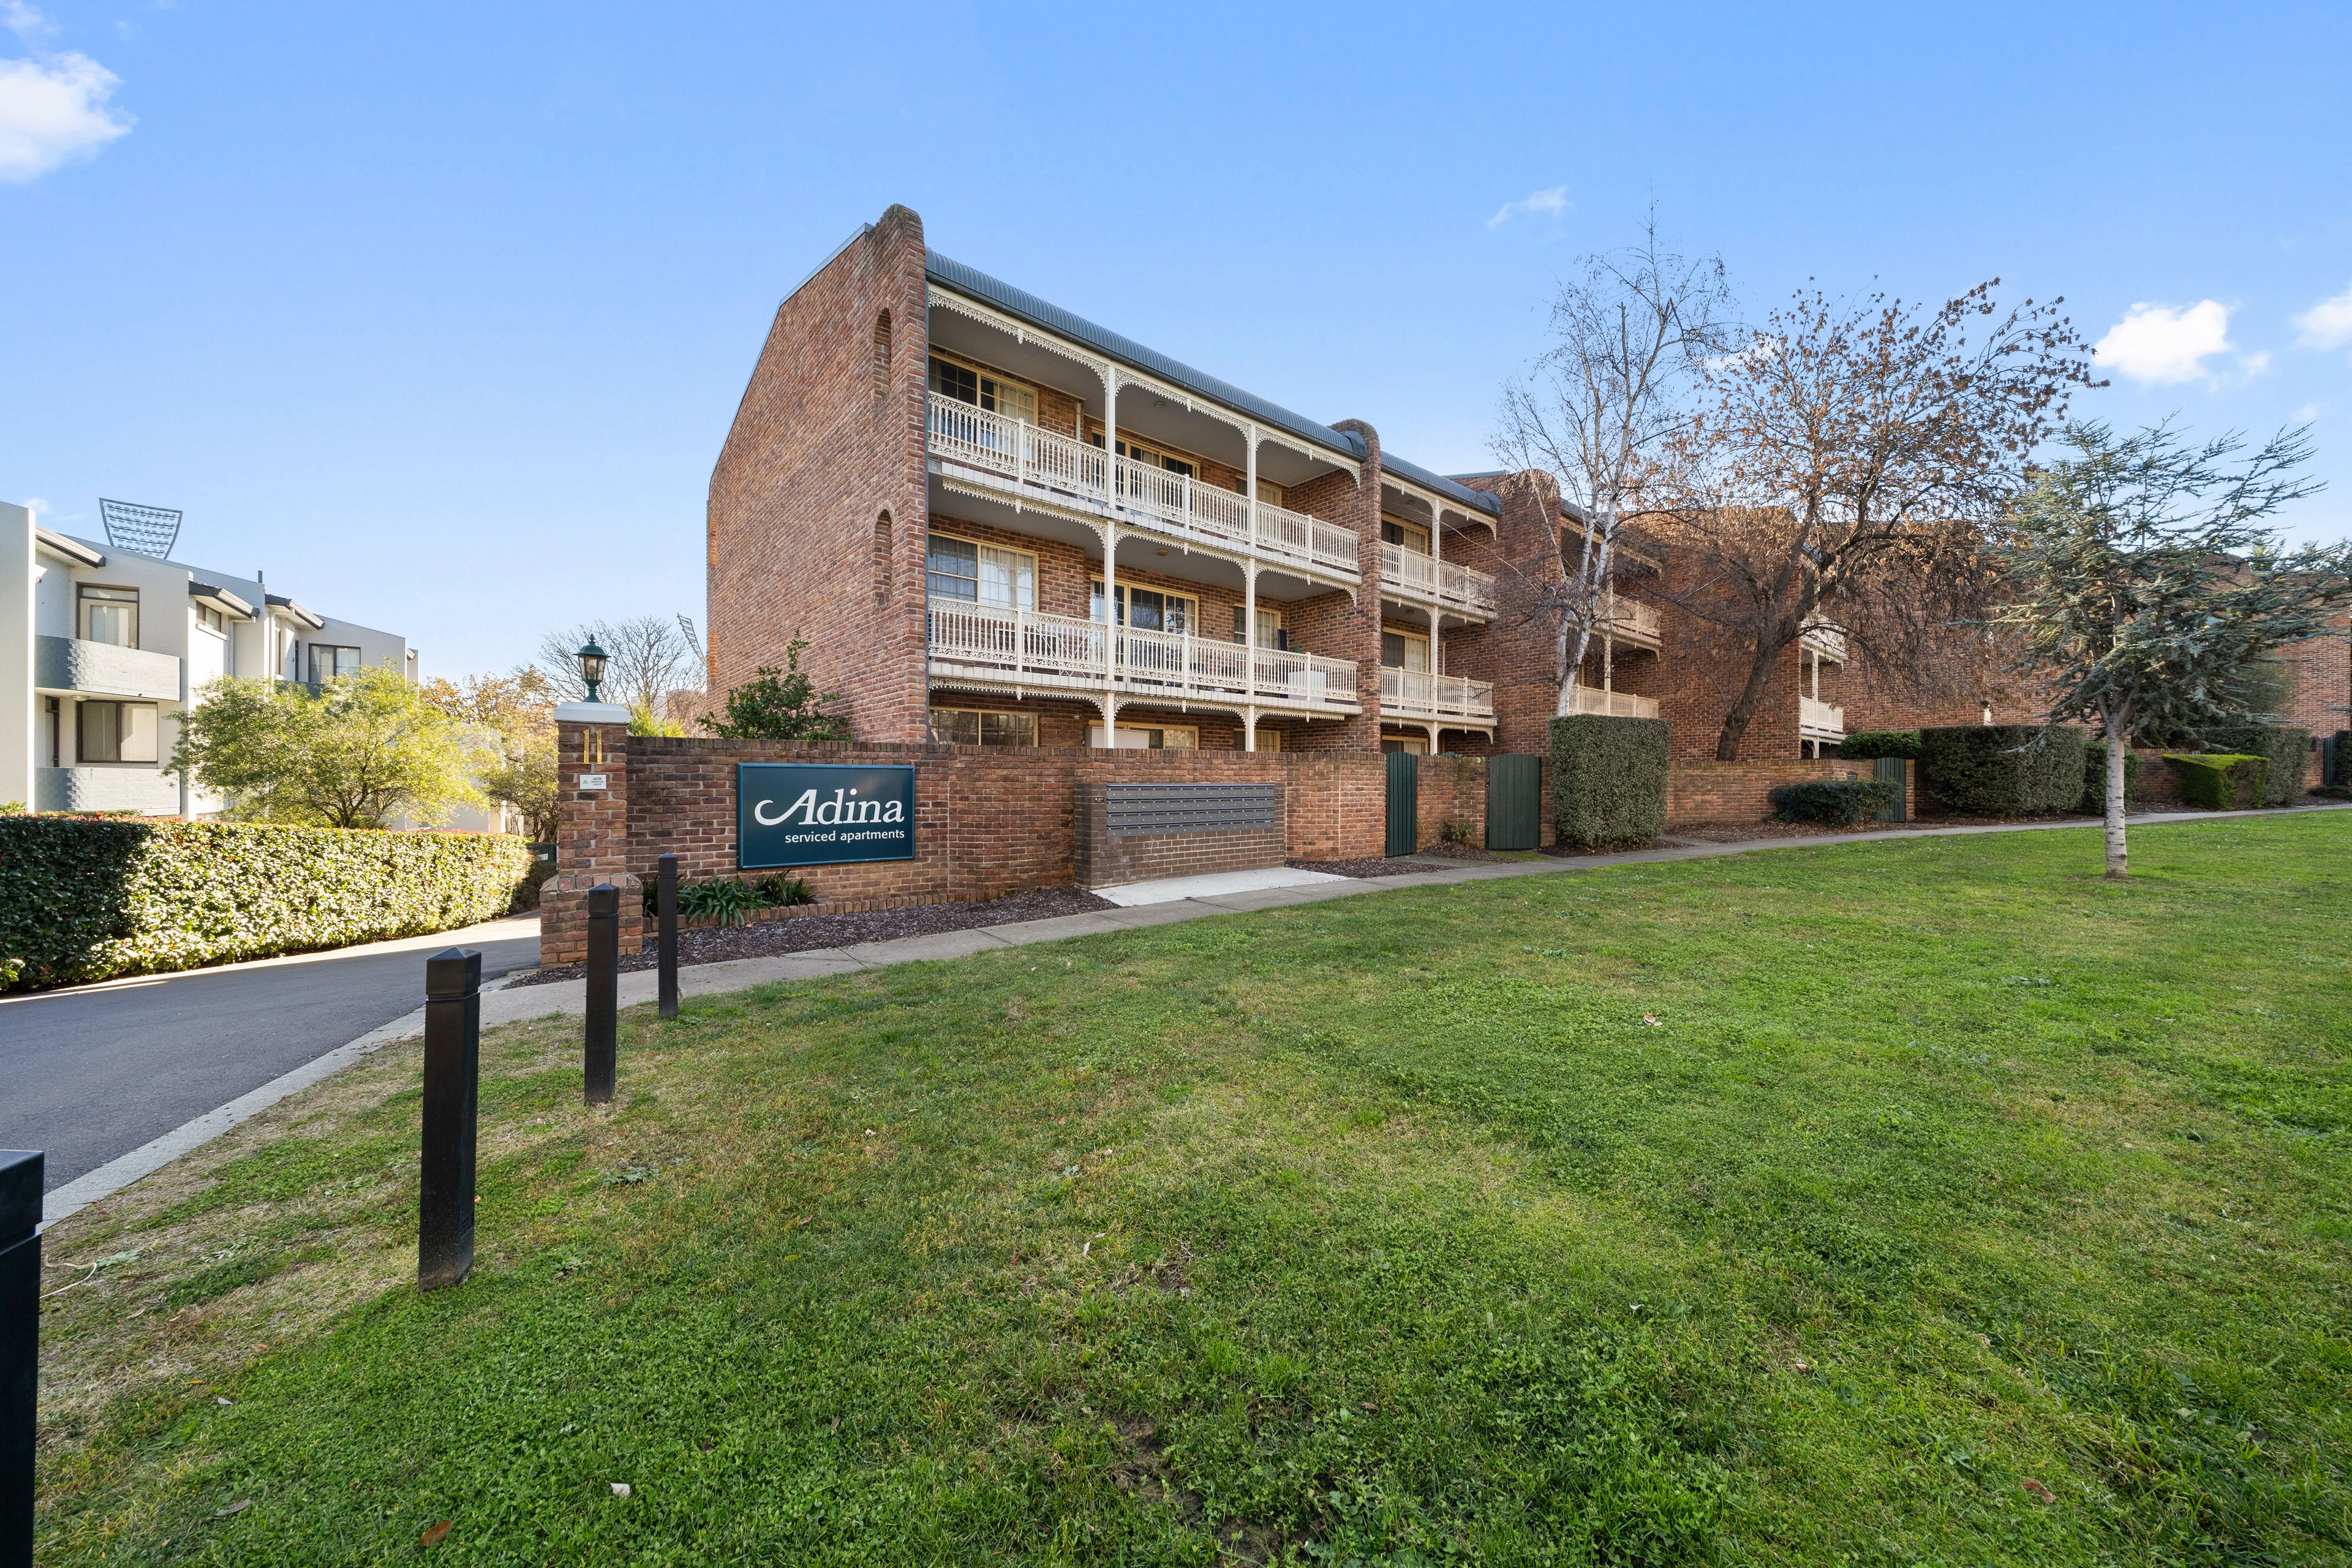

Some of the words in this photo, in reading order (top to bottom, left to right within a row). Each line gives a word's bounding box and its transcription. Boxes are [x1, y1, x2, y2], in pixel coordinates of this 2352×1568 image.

[582, 729, 603, 764] 11
[755, 788, 904, 825] Adina
[785, 831, 835, 843] serviced
[840, 830, 904, 843] apartments
